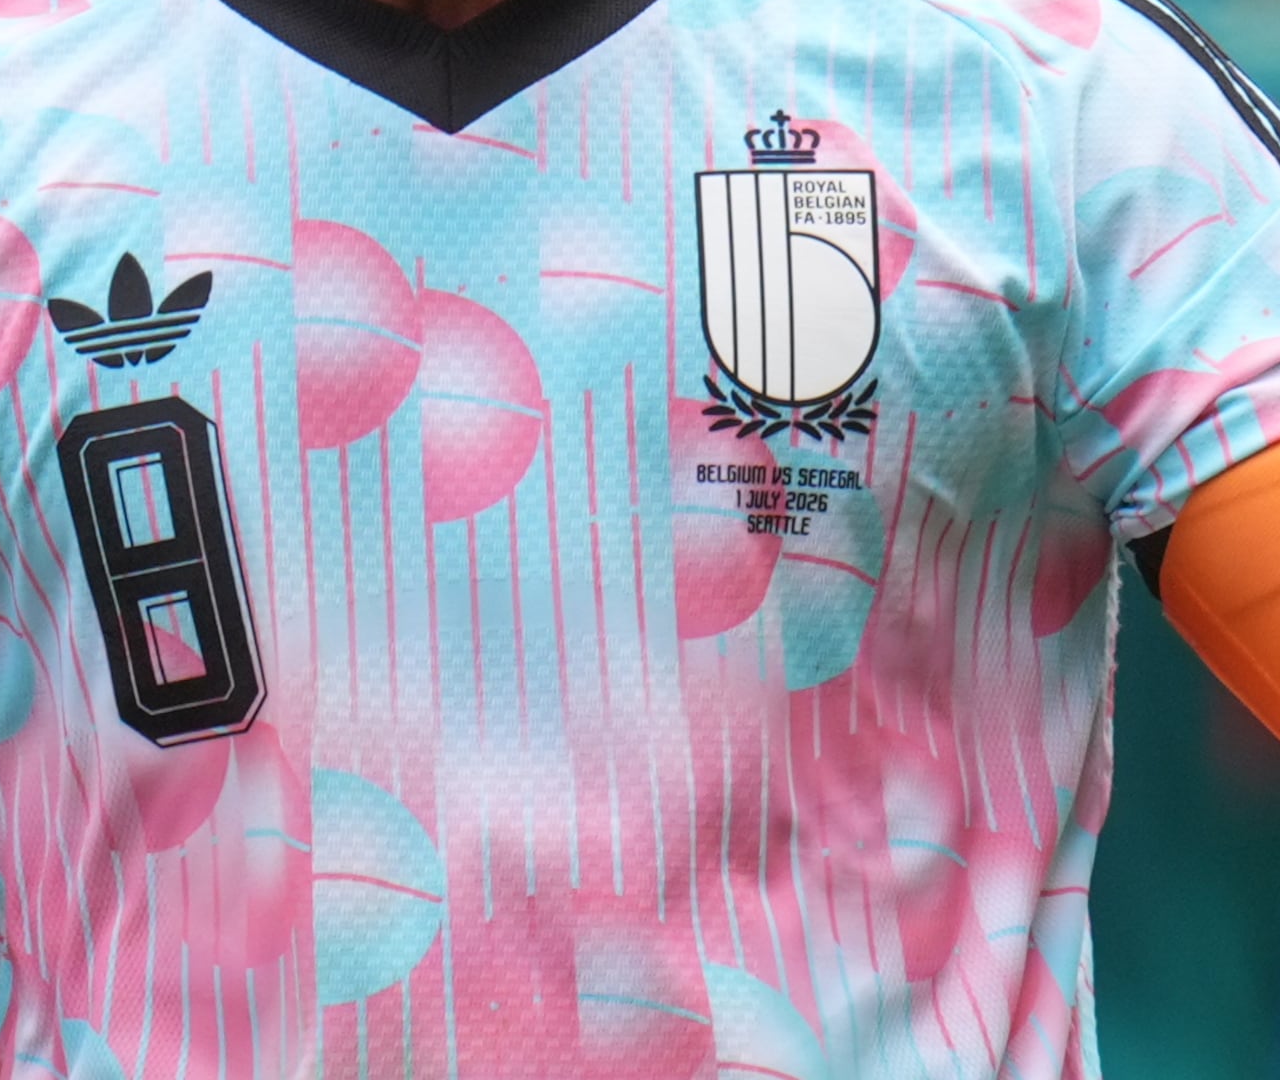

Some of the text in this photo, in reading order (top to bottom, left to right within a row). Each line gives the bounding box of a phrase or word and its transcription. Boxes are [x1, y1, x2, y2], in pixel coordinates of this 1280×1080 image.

[792, 180, 847, 194] ROYAL
[793, 195, 866, 209] BELGIAN
[696, 464, 863, 490] BELGIUM VS SENEGAL
[736, 489, 829, 513] 1 JULY 2026
[747, 514, 812, 536] SEATTLE
[56, 395, 268, 749] 8
